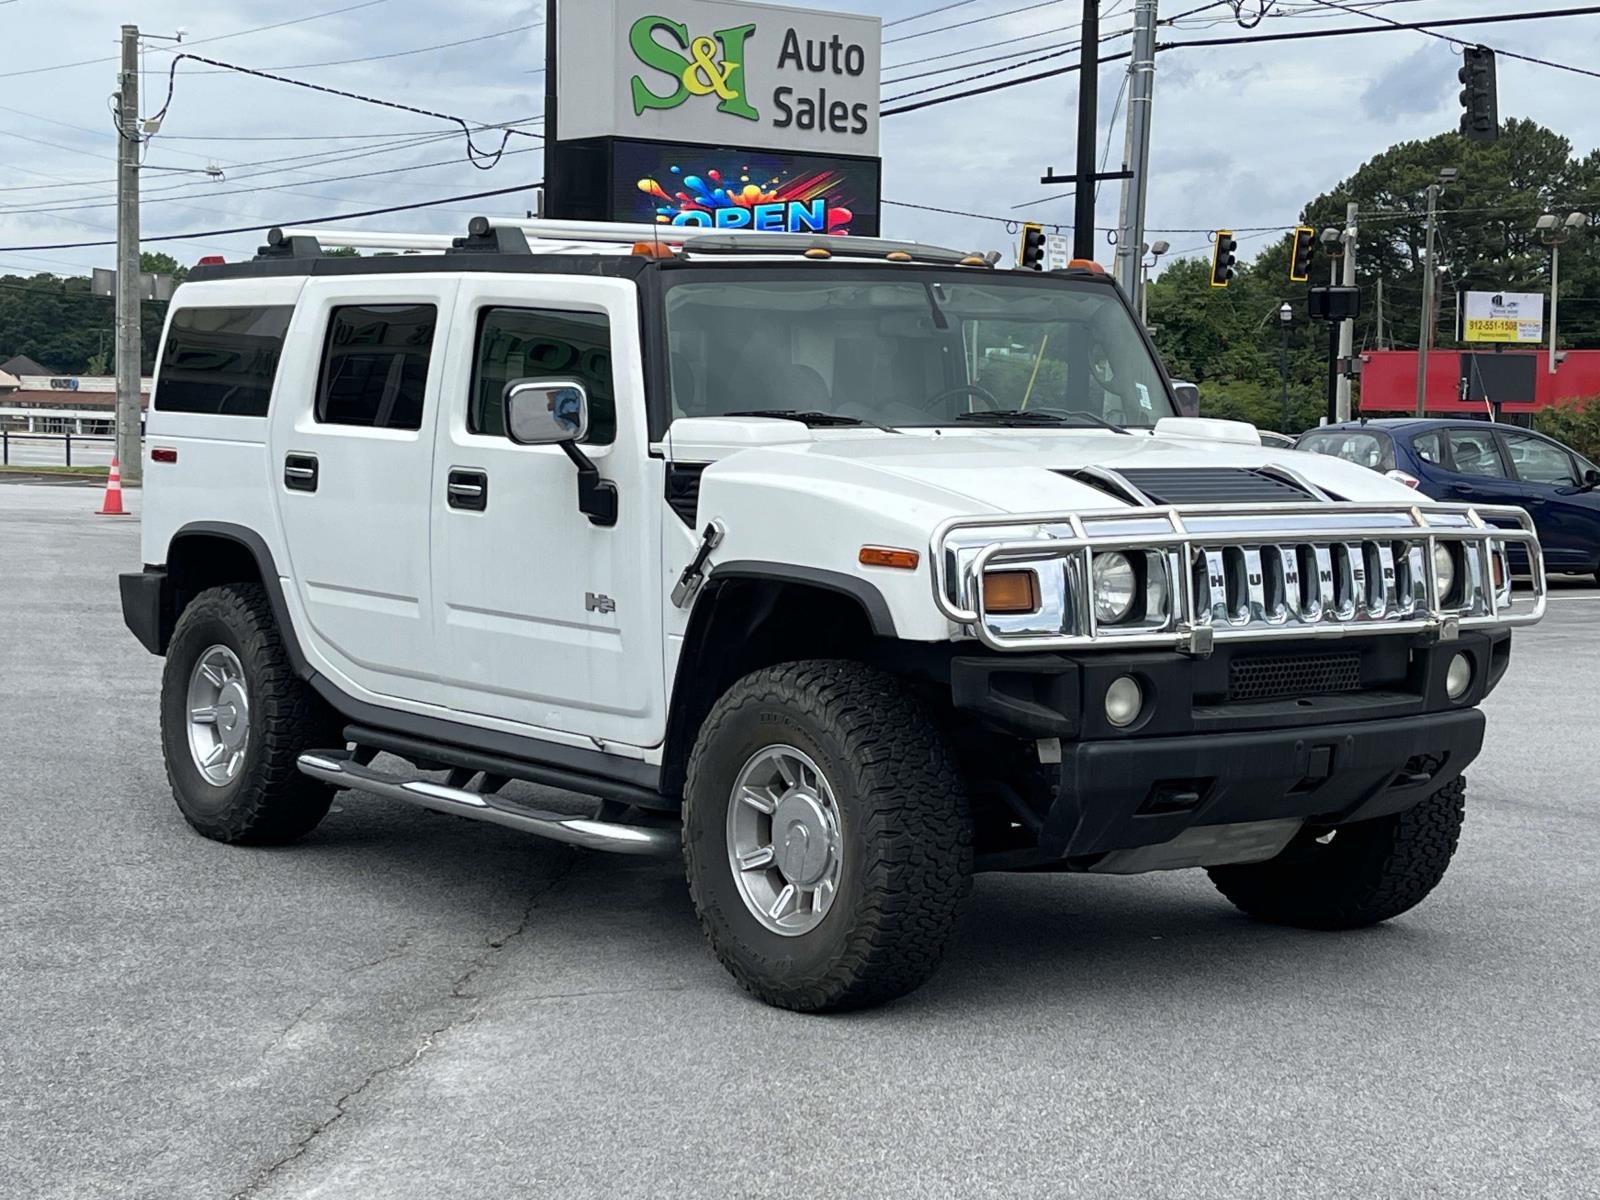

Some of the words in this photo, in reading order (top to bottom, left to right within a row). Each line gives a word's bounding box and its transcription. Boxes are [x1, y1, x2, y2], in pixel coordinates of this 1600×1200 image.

[629, 15, 759, 121] S&I
[777, 27, 865, 76] Auto
[773, 86, 868, 135] Sales
[671, 199, 826, 232] OPEN
[1210, 568, 1396, 587] HUMMER
[585, 592, 616, 614] H2
